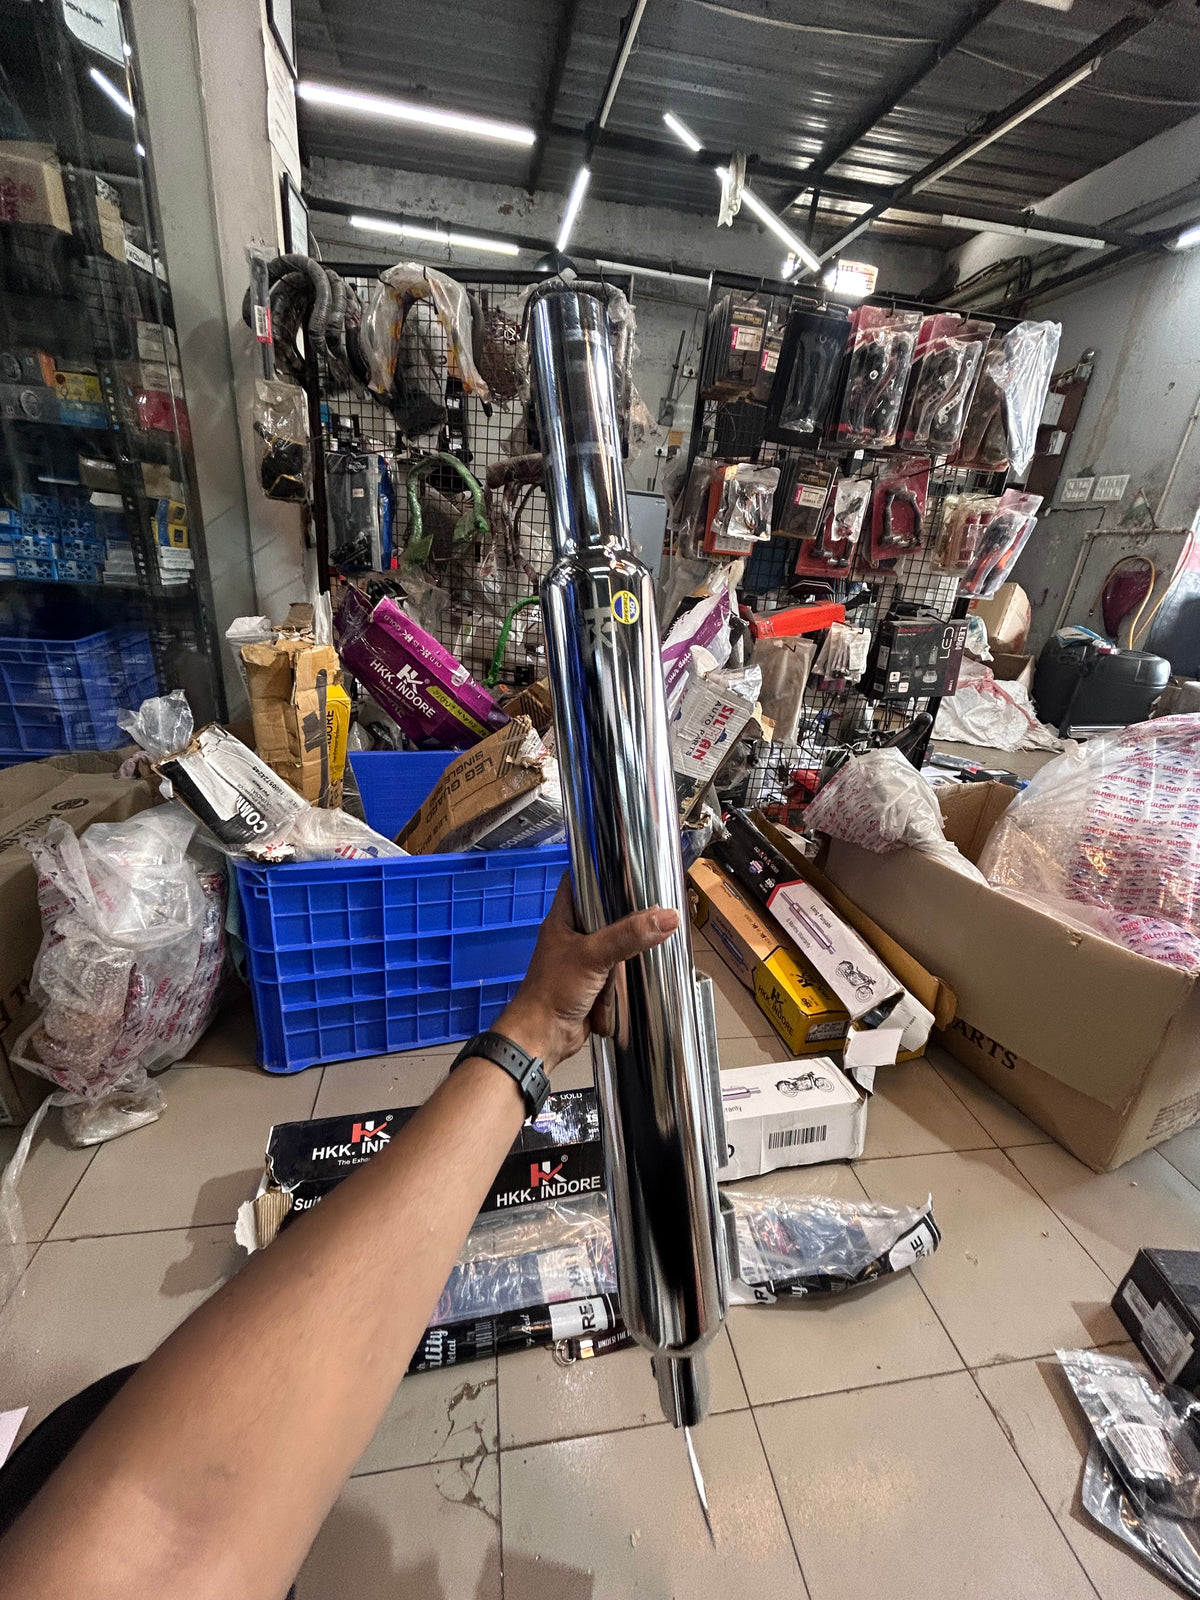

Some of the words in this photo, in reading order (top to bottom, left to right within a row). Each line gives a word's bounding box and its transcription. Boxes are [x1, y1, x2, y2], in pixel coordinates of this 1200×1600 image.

[629, 600, 637, 615] OK
[959, 626, 967, 642] LED
[395, 680, 436, 719] INDORE
[704, 700, 722, 726] AUTO
[685, 729, 705, 757] PARTS
[692, 705, 734, 761] SILMAN
[447, 750, 484, 782] SINGLE
[465, 756, 494, 782] LEG
[1126, 777, 1152, 787] SILMAN
[1155, 783, 1182, 793] SILMAN
[425, 778, 461, 823] GUARD
[1119, 795, 1146, 806] SILMAN
[1113, 813, 1140, 824] SILMAN
[809, 904, 821, 917] Long
[771, 1003, 795, 1036] INDORE
[952, 1017, 1018, 1071] ARTS
[723, 1104, 742, 1114] ranty
[312, 1143, 356, 1162] HKK.
[337, 1158, 352, 1168] The
[496, 1191, 536, 1207] HKK.
[540, 1174, 601, 1199] INDORE
